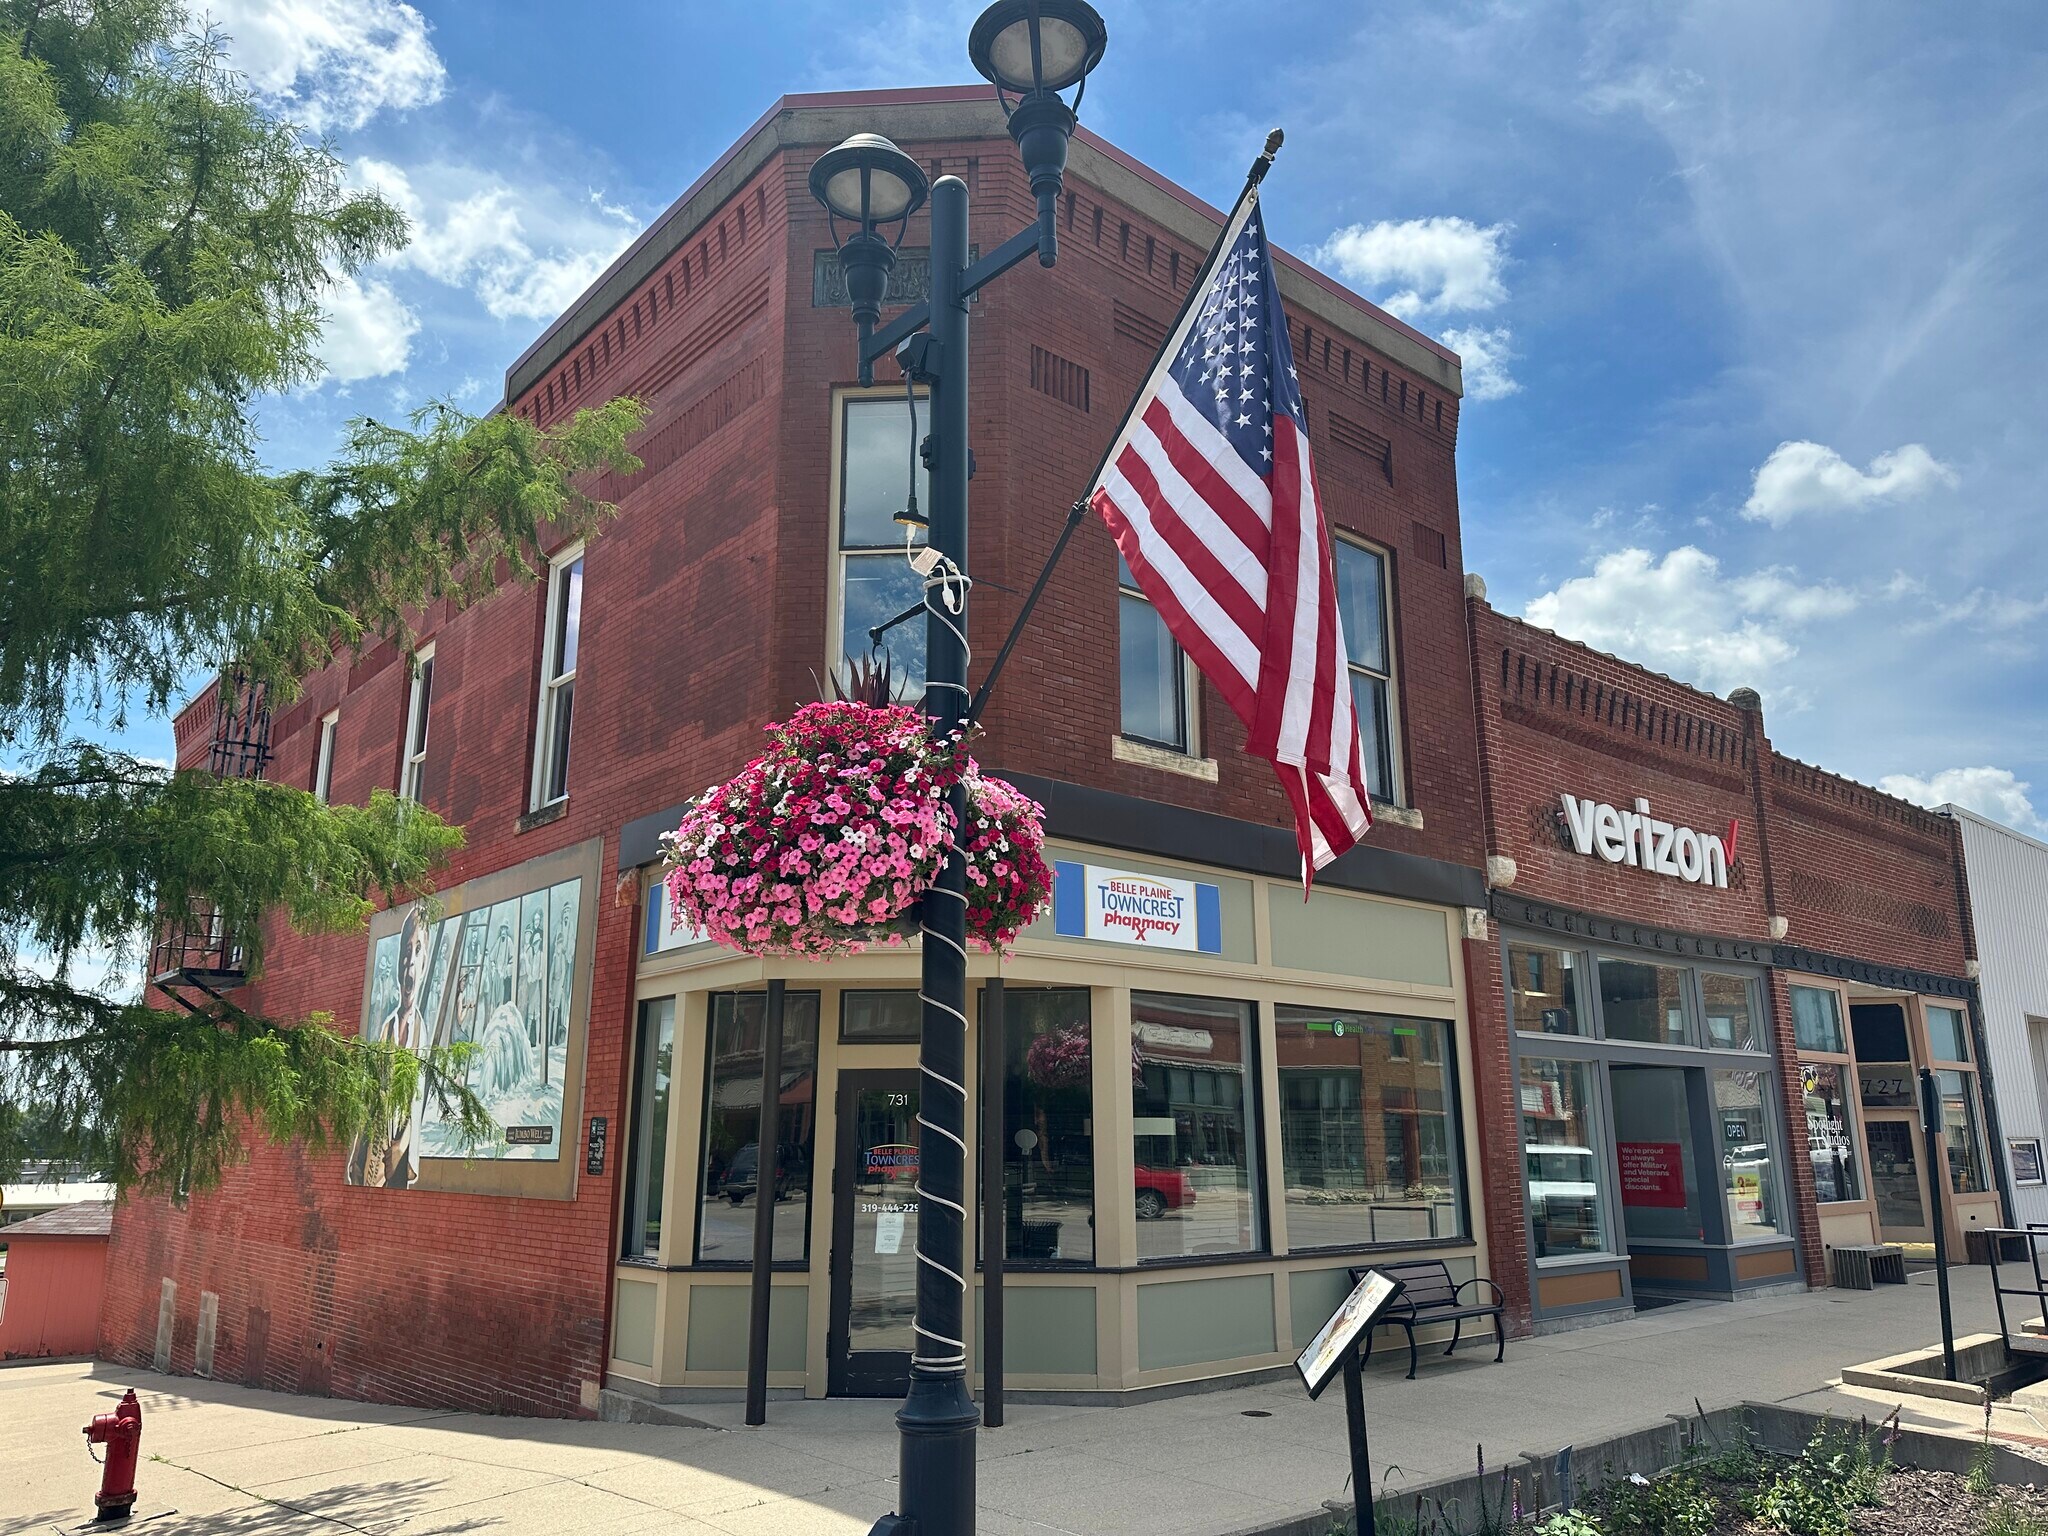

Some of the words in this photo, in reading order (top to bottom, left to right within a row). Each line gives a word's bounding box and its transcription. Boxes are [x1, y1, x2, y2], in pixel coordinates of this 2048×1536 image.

[1561, 793, 1728, 888] verizon
[1110, 881, 1137, 895] BELLE
[1139, 886, 1172, 900] PLAINE
[1097, 885, 1184, 919] TOWNCREST
[1861, 1079, 1903, 1095] 727
[888, 1094, 908, 1106] 731
[1727, 1124, 1746, 1138] OPEN
[1807, 1115, 1844, 1134] Spotlight
[864, 1152, 920, 1165] TOWNCRES
[1640, 1162, 1668, 1170] Military
